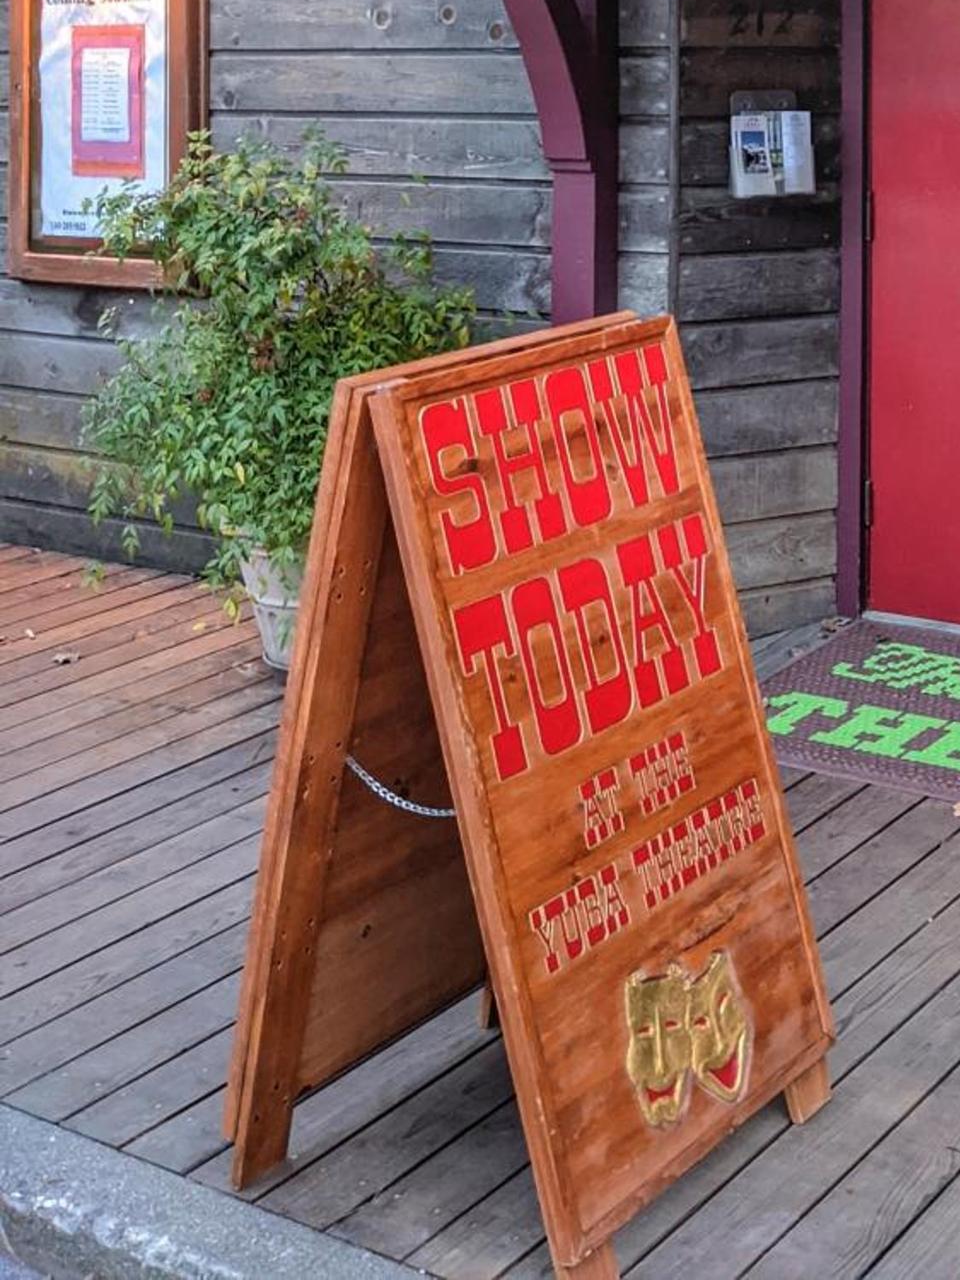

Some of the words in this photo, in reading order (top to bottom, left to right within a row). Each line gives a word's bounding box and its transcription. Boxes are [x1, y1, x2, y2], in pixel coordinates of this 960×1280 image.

[418, 343, 679, 576] SHOW
[451, 514, 724, 782] TODAY
[527, 863, 632, 974] YUBA
[630, 778, 767, 912] THEATRE
[577, 767, 625, 850] AT
[627, 730, 697, 817] THE
